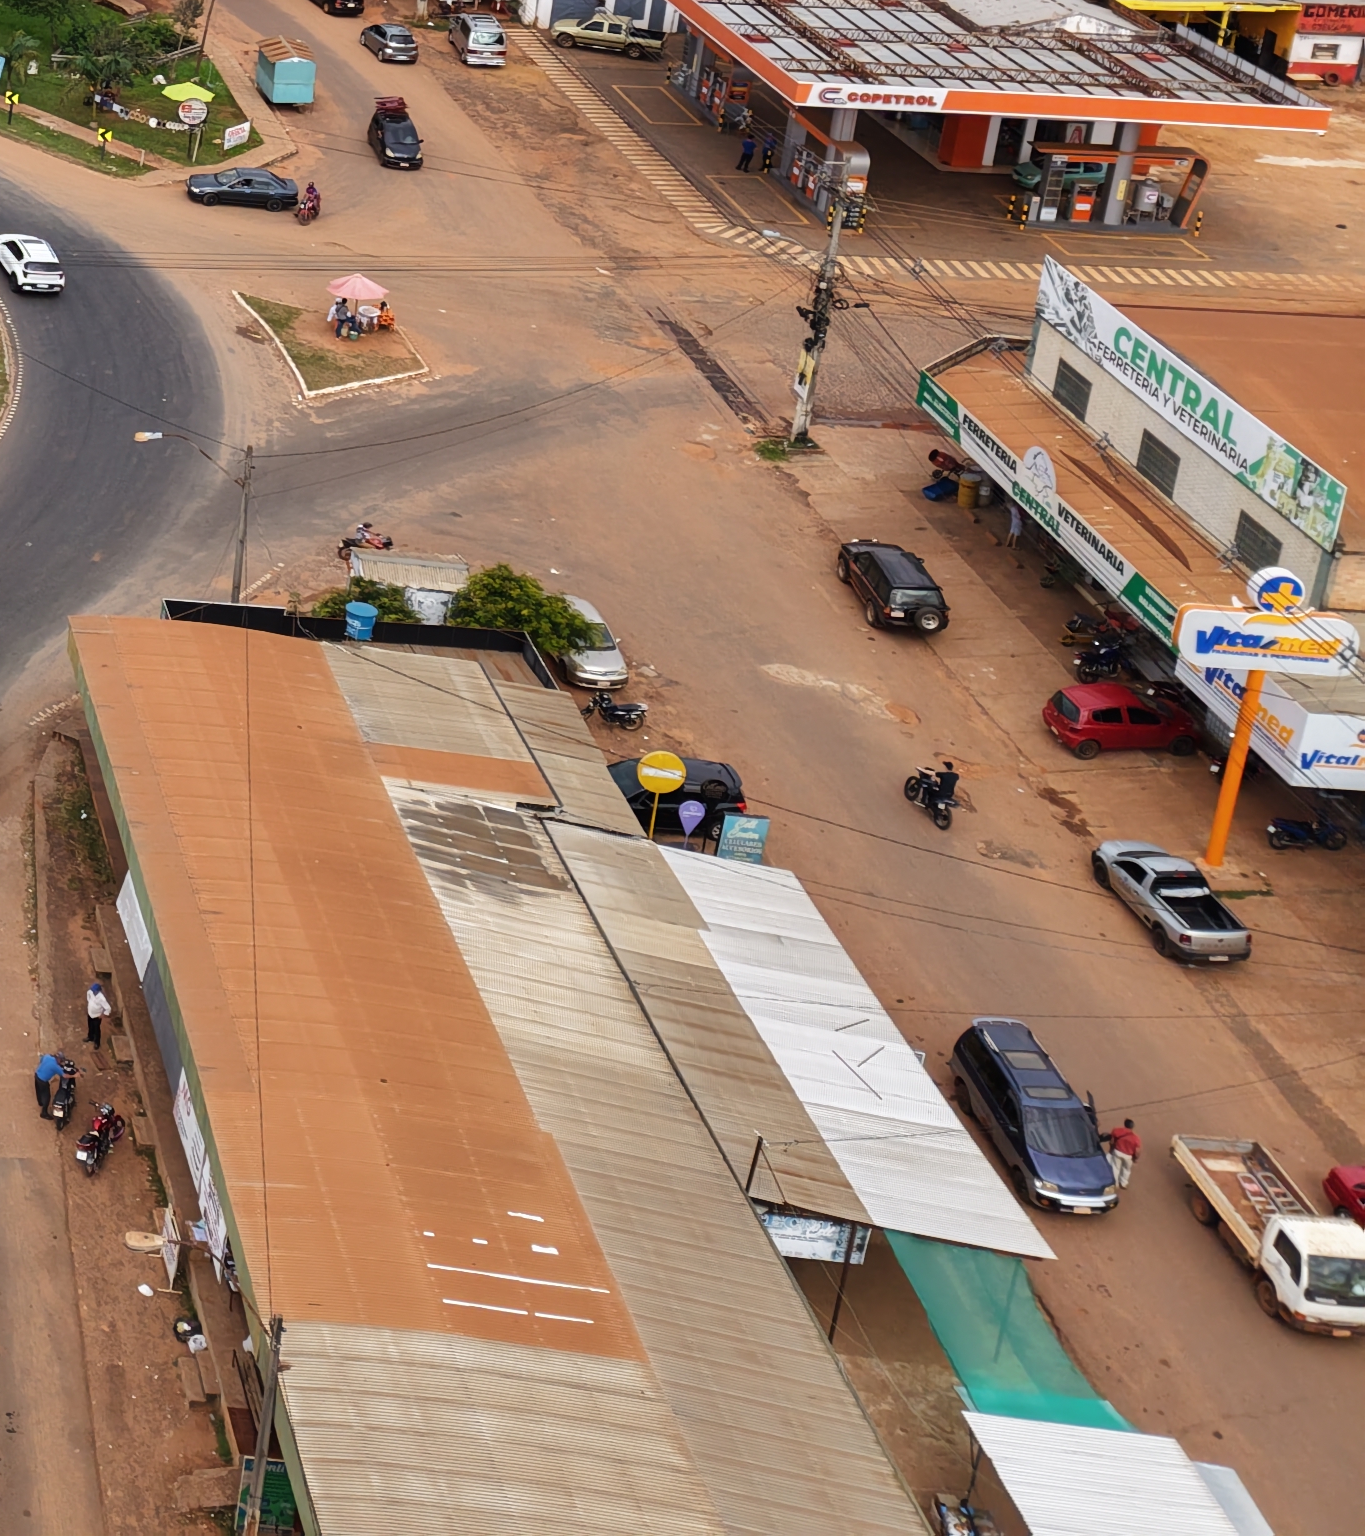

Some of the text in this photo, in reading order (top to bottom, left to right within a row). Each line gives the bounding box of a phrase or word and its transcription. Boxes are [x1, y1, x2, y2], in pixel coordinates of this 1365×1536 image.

[847, 92, 937, 107] COPETROL
[1096, 341, 1250, 474] FERRETERIA Y VETERINARIA
[1113, 326, 1238, 447] CENTRAL
[962, 413, 1019, 475] FERRETERIA
[1011, 480, 1062, 539] CENTRAL
[1057, 502, 1125, 577] VETERINARIA
